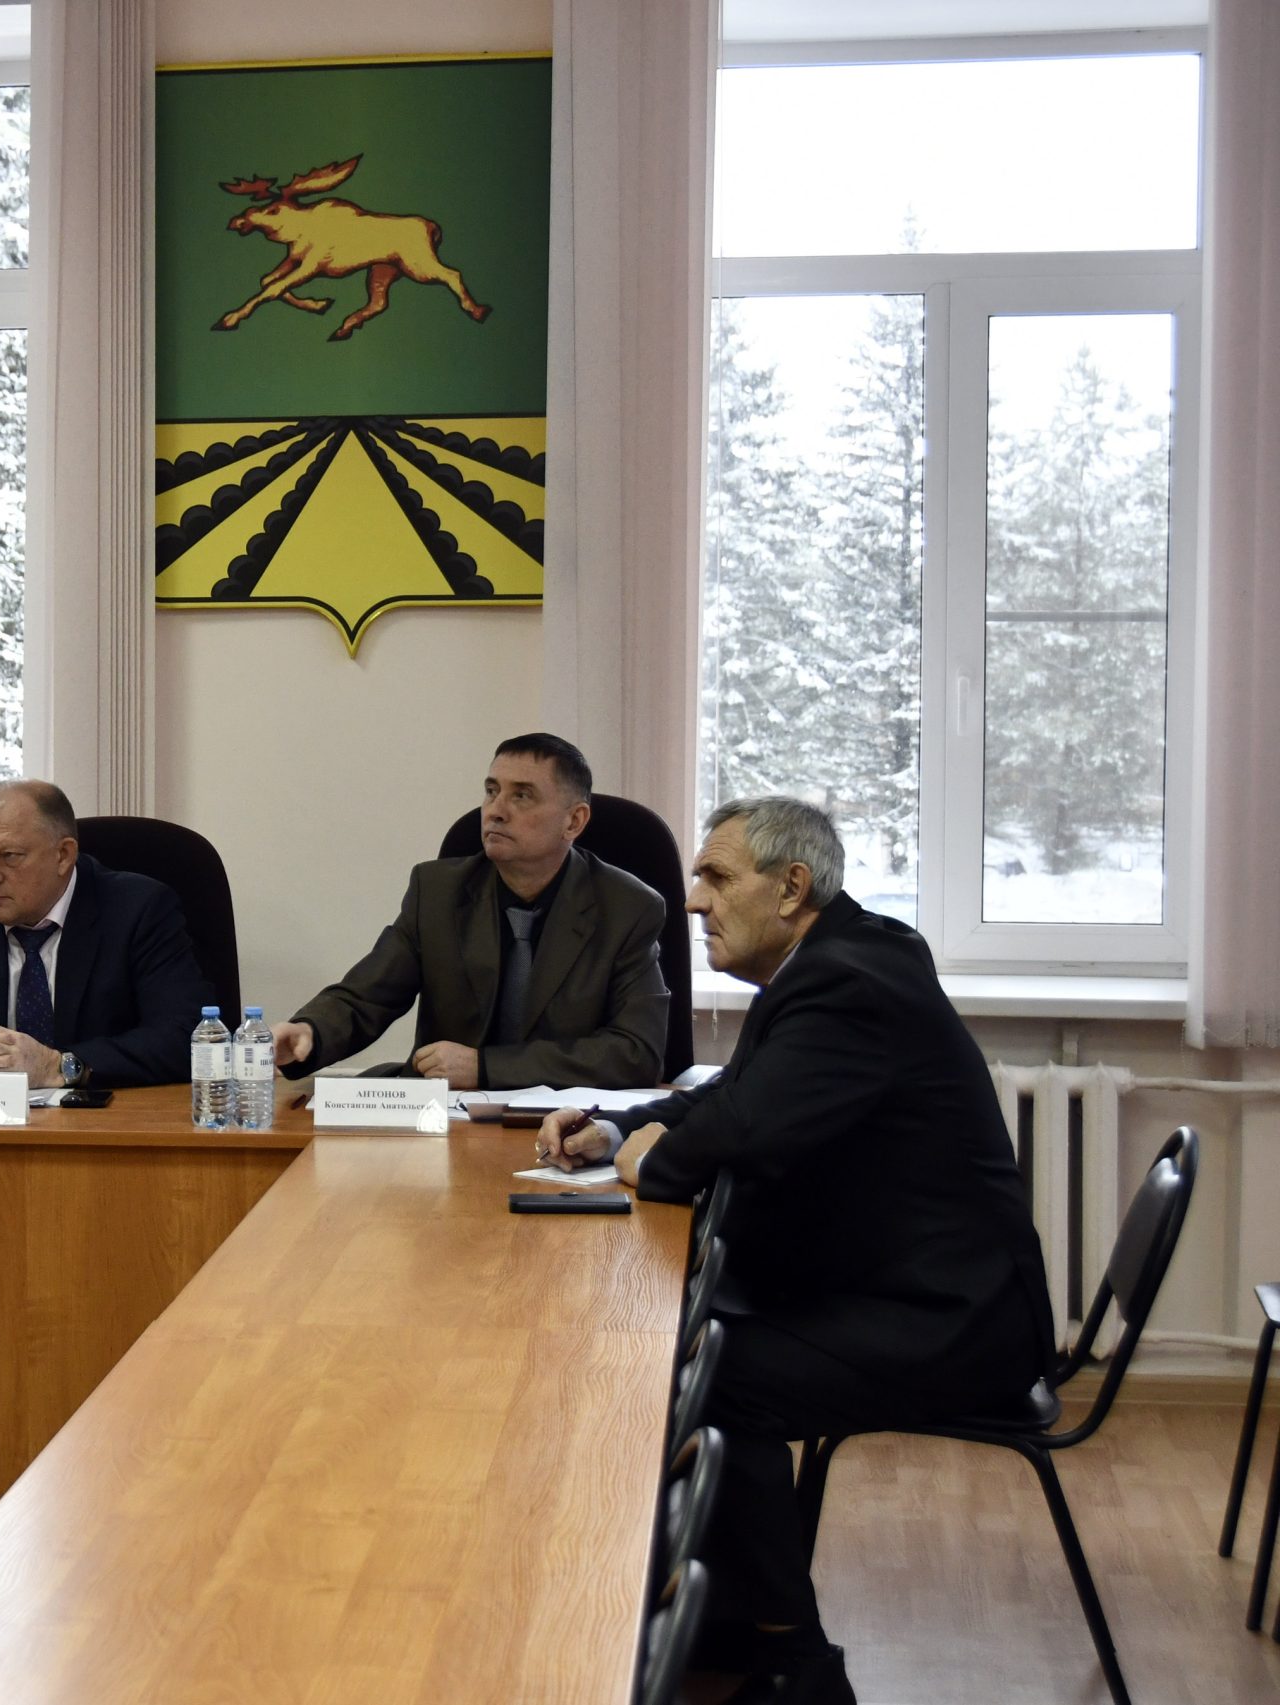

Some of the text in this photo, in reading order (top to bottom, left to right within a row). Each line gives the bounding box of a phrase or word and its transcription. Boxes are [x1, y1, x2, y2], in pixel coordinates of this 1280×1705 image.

[356, 1090, 406, 1099] АНТОНОВ
[324, 1101, 436, 1111] Константин Анатольев
